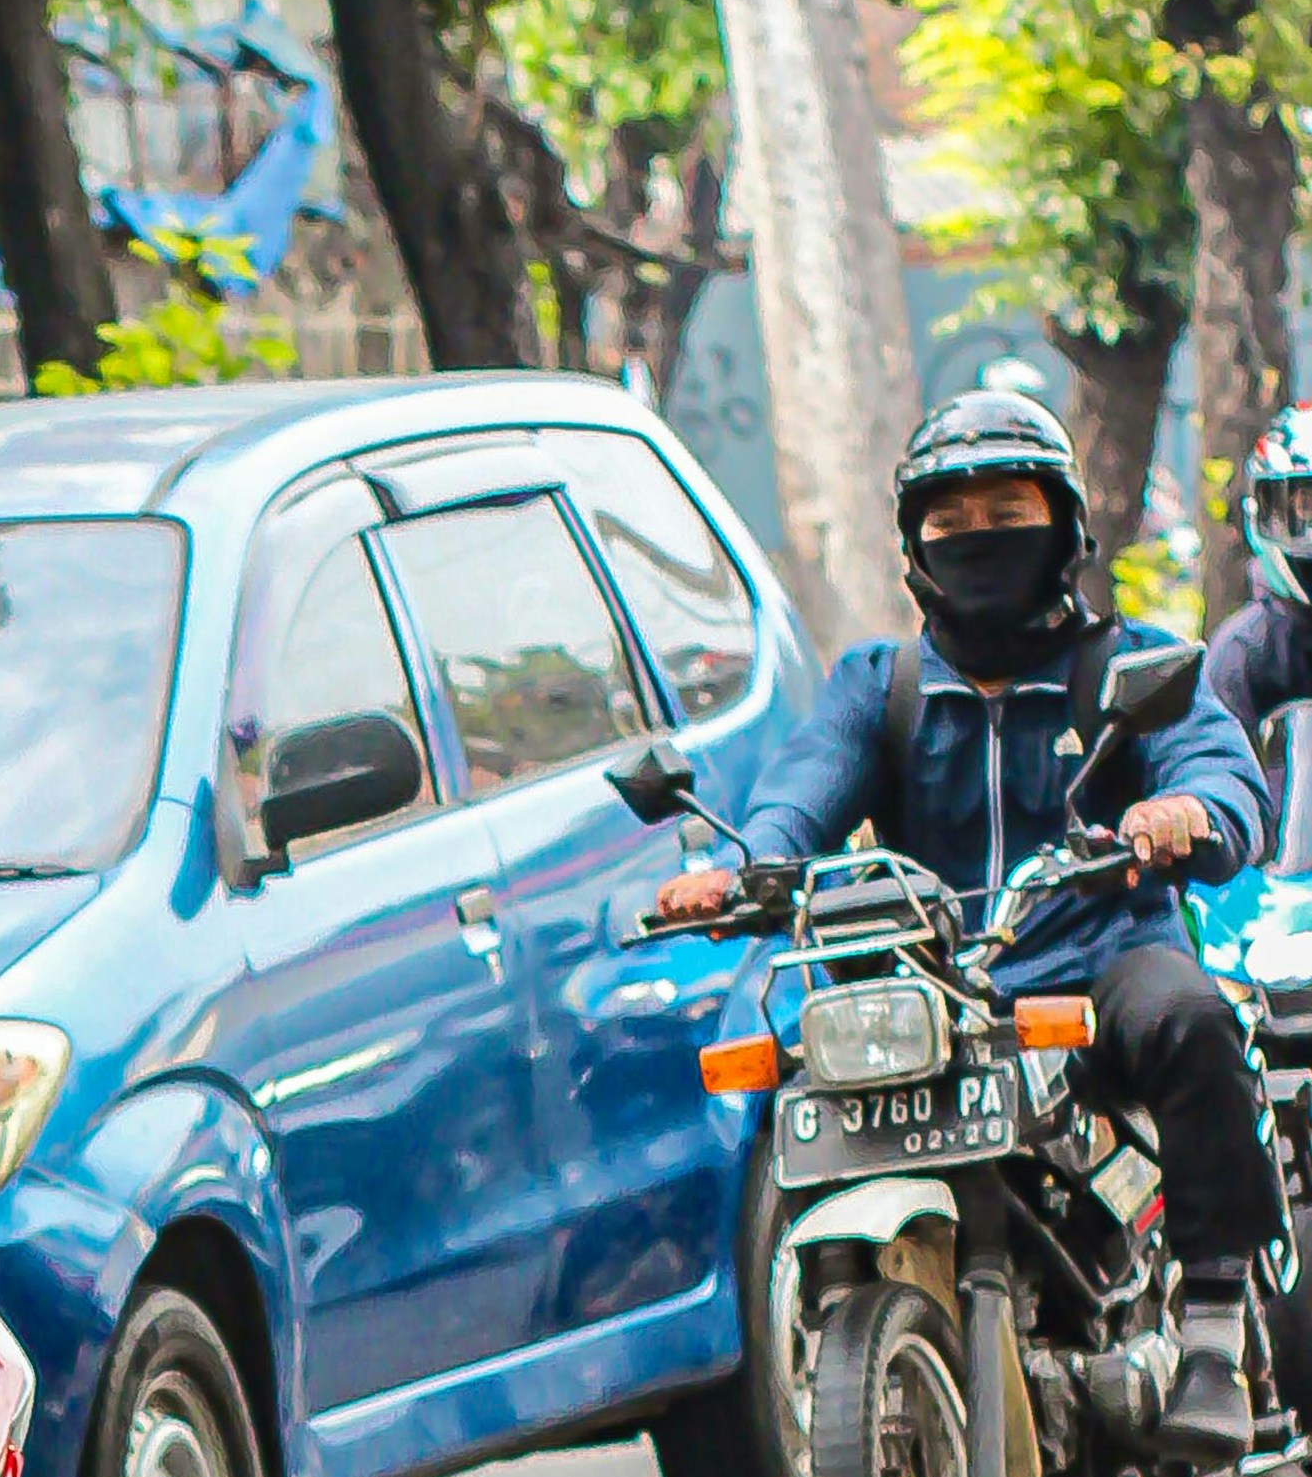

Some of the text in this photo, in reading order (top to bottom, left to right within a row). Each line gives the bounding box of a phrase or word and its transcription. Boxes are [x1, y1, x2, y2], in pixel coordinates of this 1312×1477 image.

[794, 1075, 1003, 1140] G 3760 PA
